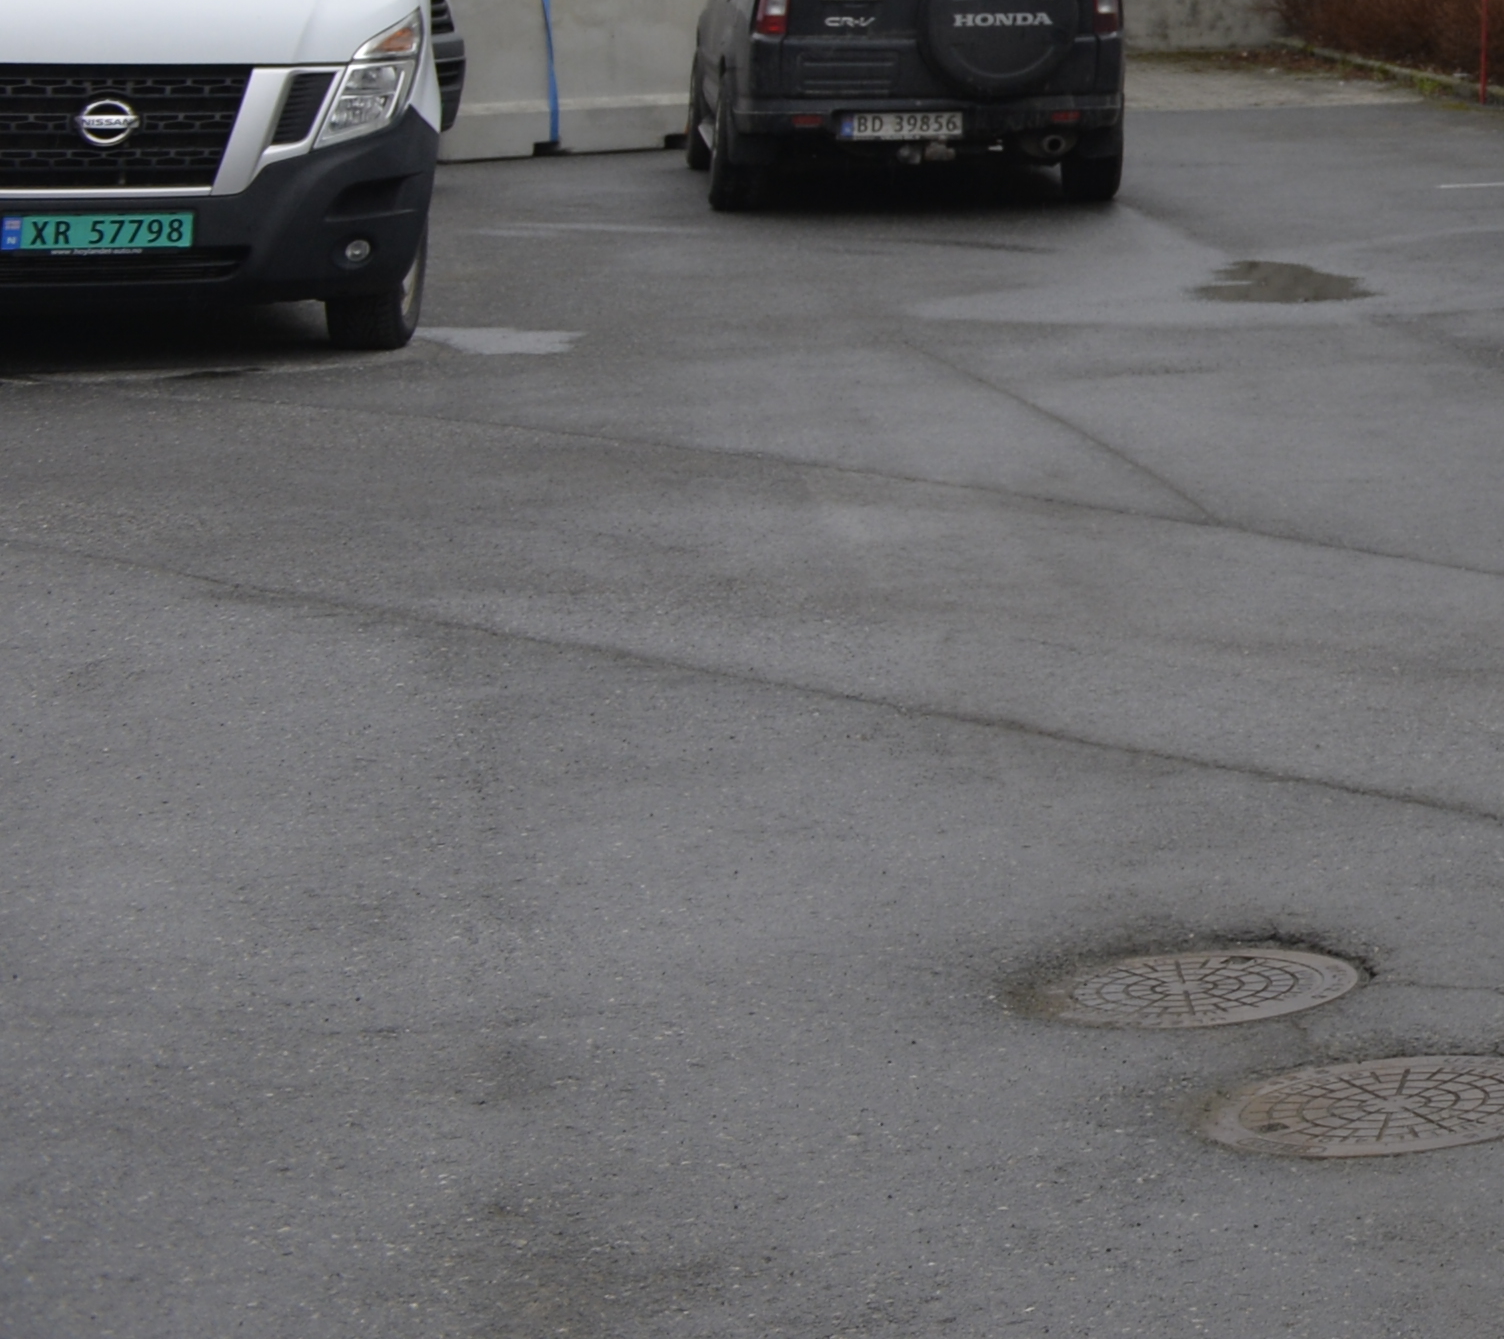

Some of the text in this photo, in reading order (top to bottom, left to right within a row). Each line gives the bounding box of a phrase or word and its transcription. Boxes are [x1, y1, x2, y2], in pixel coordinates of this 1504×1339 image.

[824, 16, 876, 28] CR-V
[953, 12, 1054, 27] HONDA
[80, 118, 133, 127] NISSAN
[856, 114, 958, 133] BD 39856
[29, 221, 71, 246] XR
[88, 218, 184, 245] 57798
